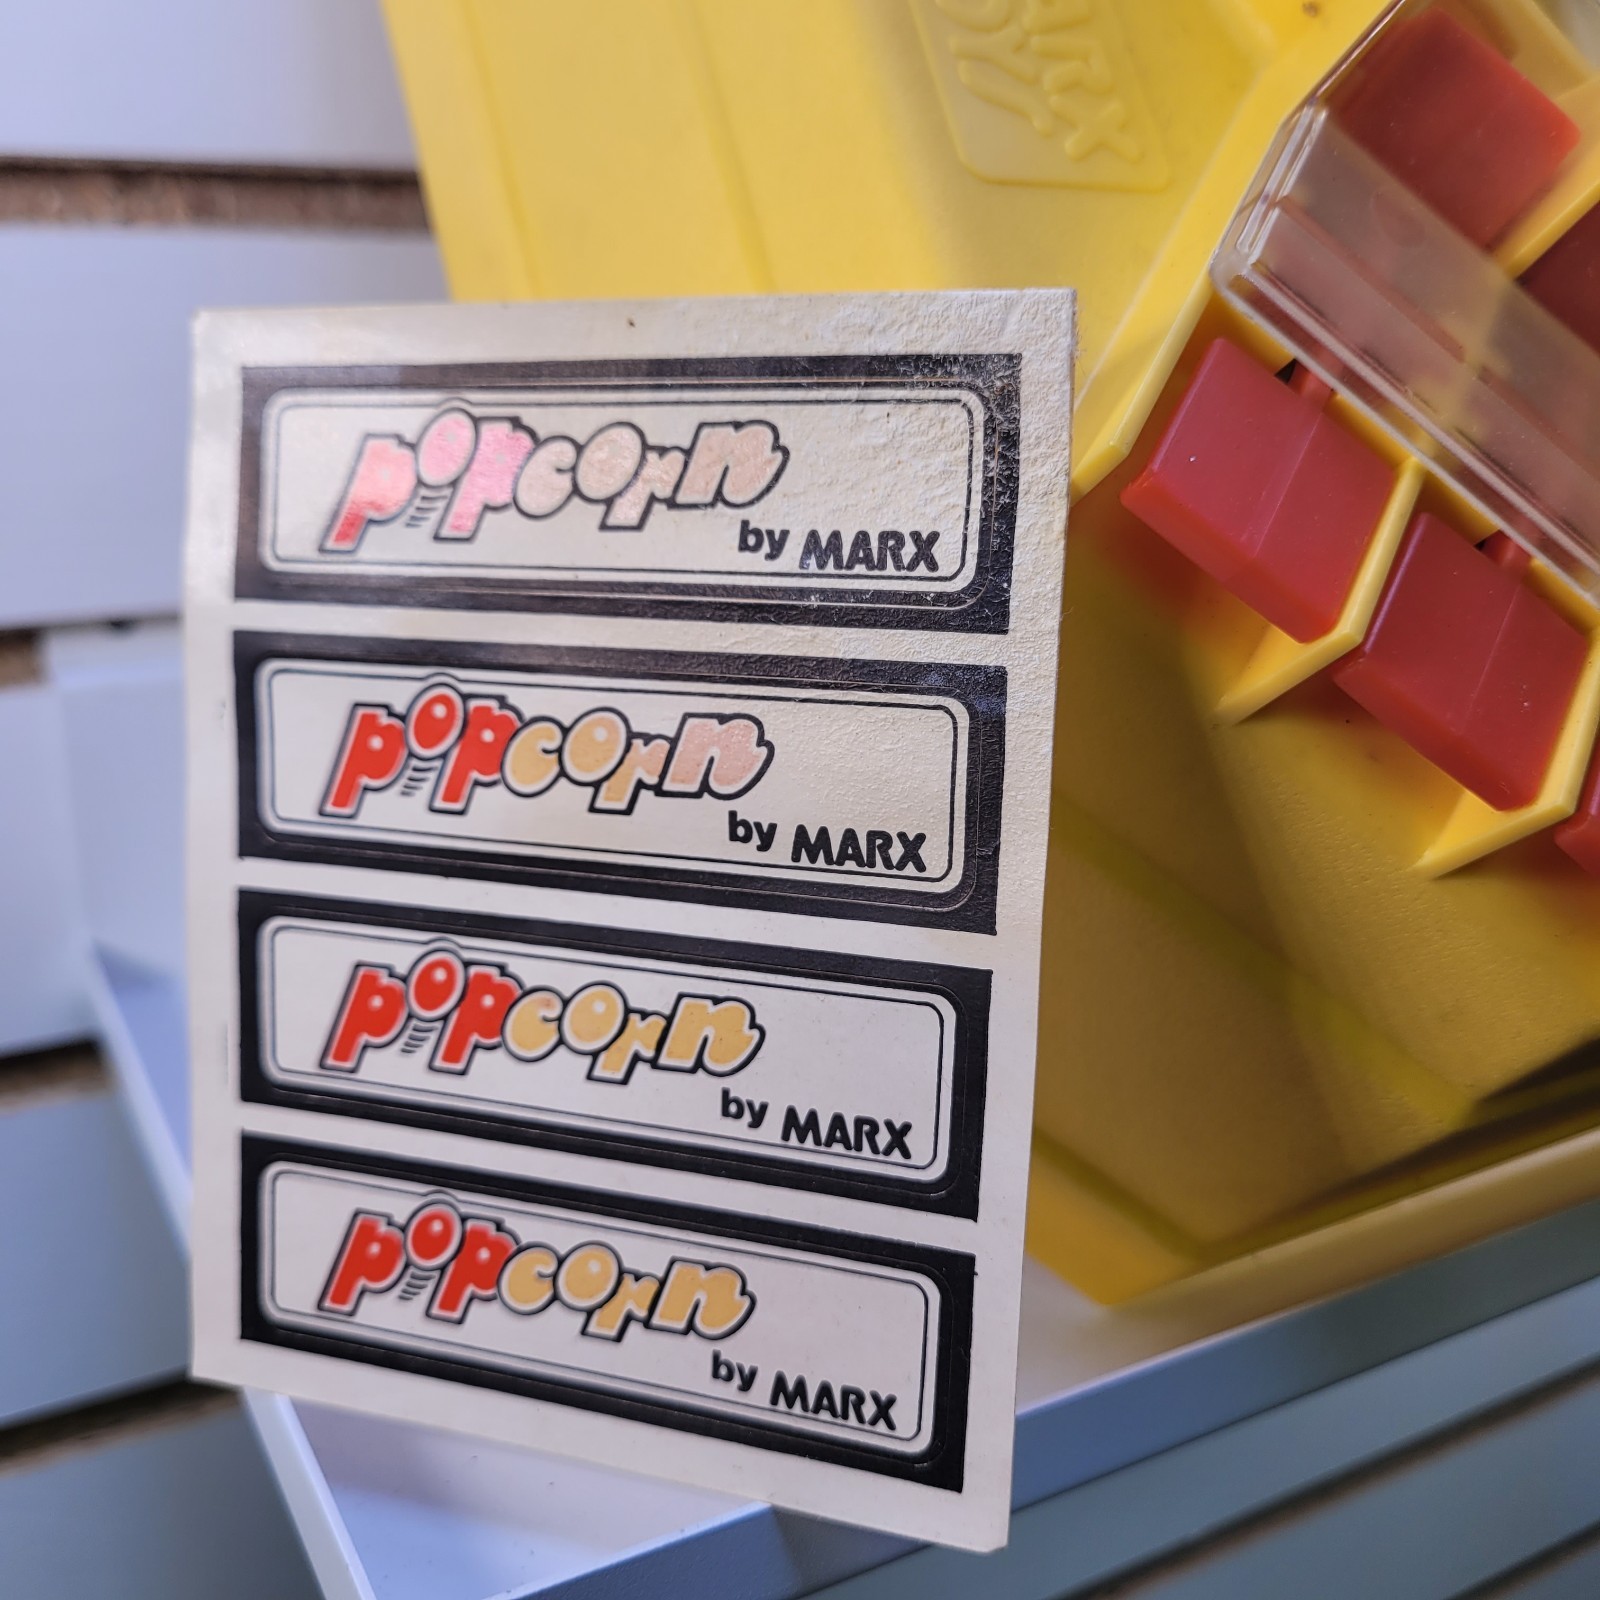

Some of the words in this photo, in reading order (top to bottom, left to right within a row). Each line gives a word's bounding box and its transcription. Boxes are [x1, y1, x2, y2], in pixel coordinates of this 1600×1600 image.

[319, 407, 789, 553] popcorn
[739, 520, 787, 559] by
[800, 529, 939, 572] MARX
[319, 683, 774, 818] popcorn
[728, 811, 777, 850] by
[791, 826, 927, 872] MARX
[319, 949, 765, 1085] popcorn
[721, 1088, 767, 1128] by
[781, 1106, 913, 1159] MARX
[317, 1201, 756, 1342] popcorn
[711, 1350, 757, 1391] by
[769, 1371, 897, 1431] MARX
